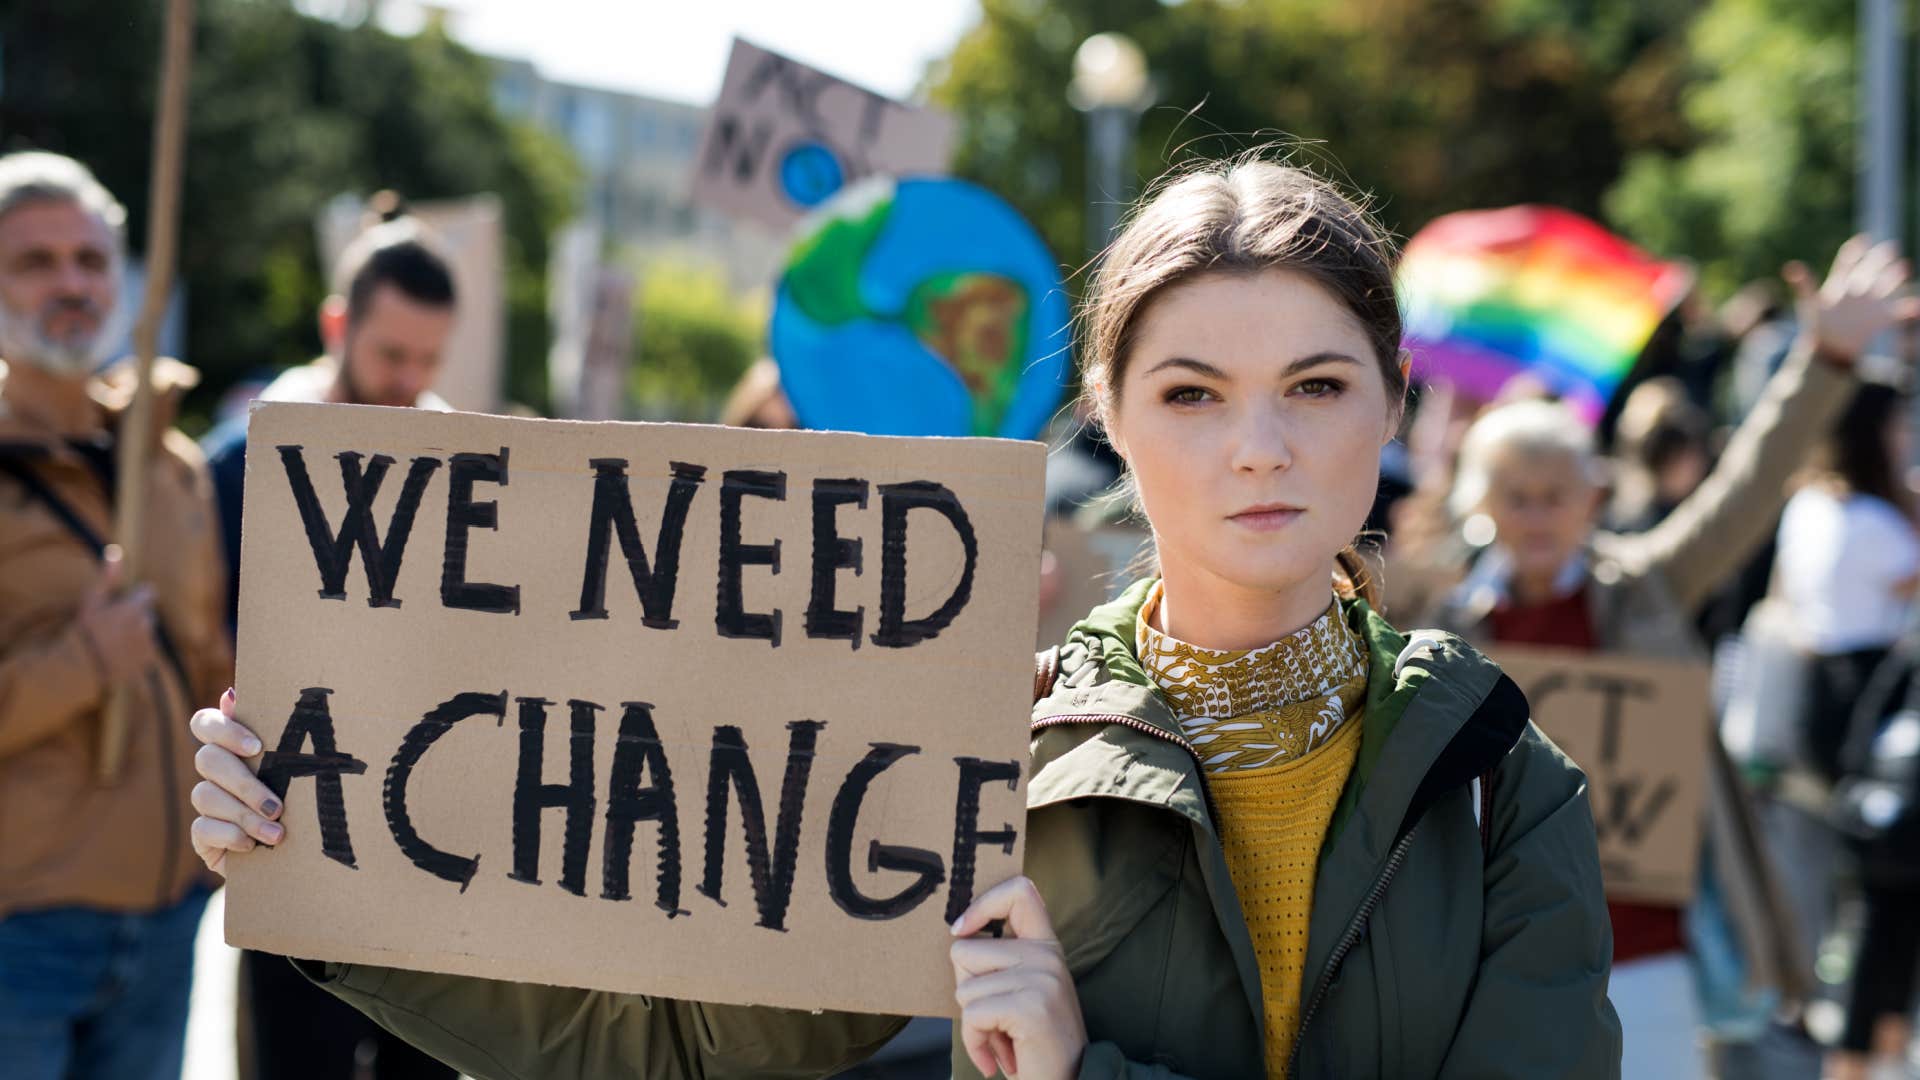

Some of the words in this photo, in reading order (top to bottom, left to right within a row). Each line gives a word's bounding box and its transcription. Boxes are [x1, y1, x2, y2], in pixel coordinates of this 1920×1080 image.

[276, 445, 521, 615] WE
[569, 459, 979, 651] NEED
[256, 686, 369, 870] A
[383, 690, 1021, 935] CHANGE
